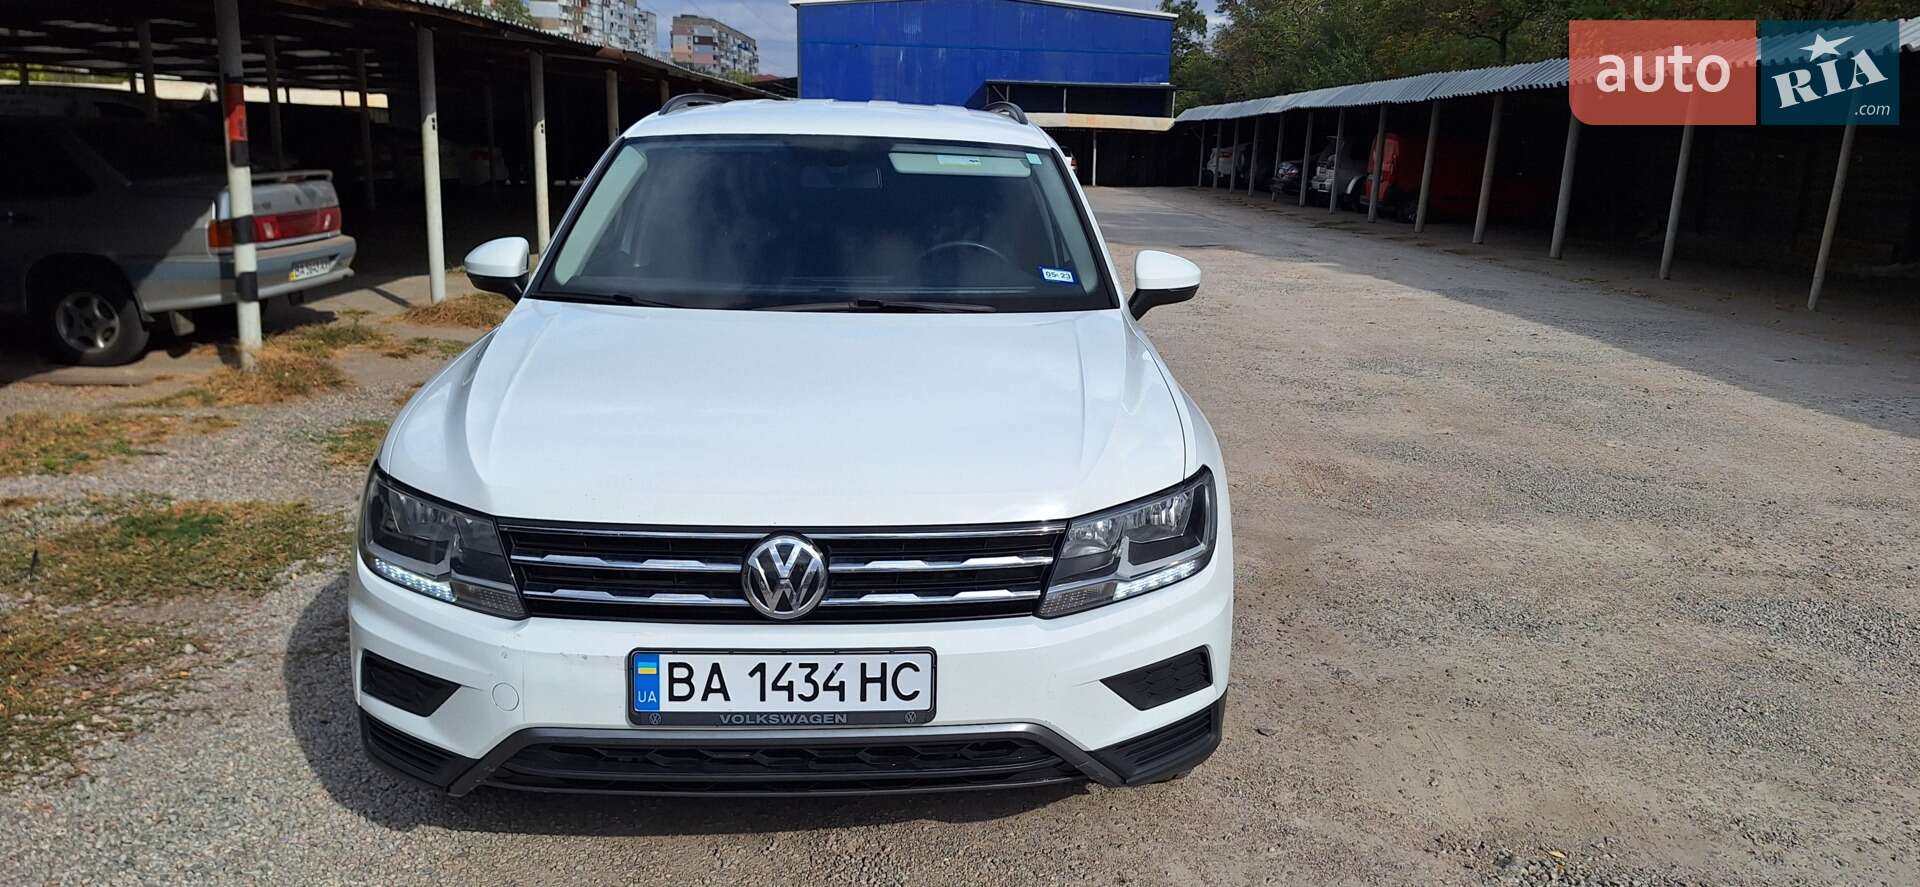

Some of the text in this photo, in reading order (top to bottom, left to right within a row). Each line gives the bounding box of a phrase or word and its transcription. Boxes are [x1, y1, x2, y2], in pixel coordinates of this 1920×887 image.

[667, 662, 921, 702] BA 1434 HC
[638, 691, 657, 703] UA
[719, 713, 847, 724] VOLKSWAGEN
